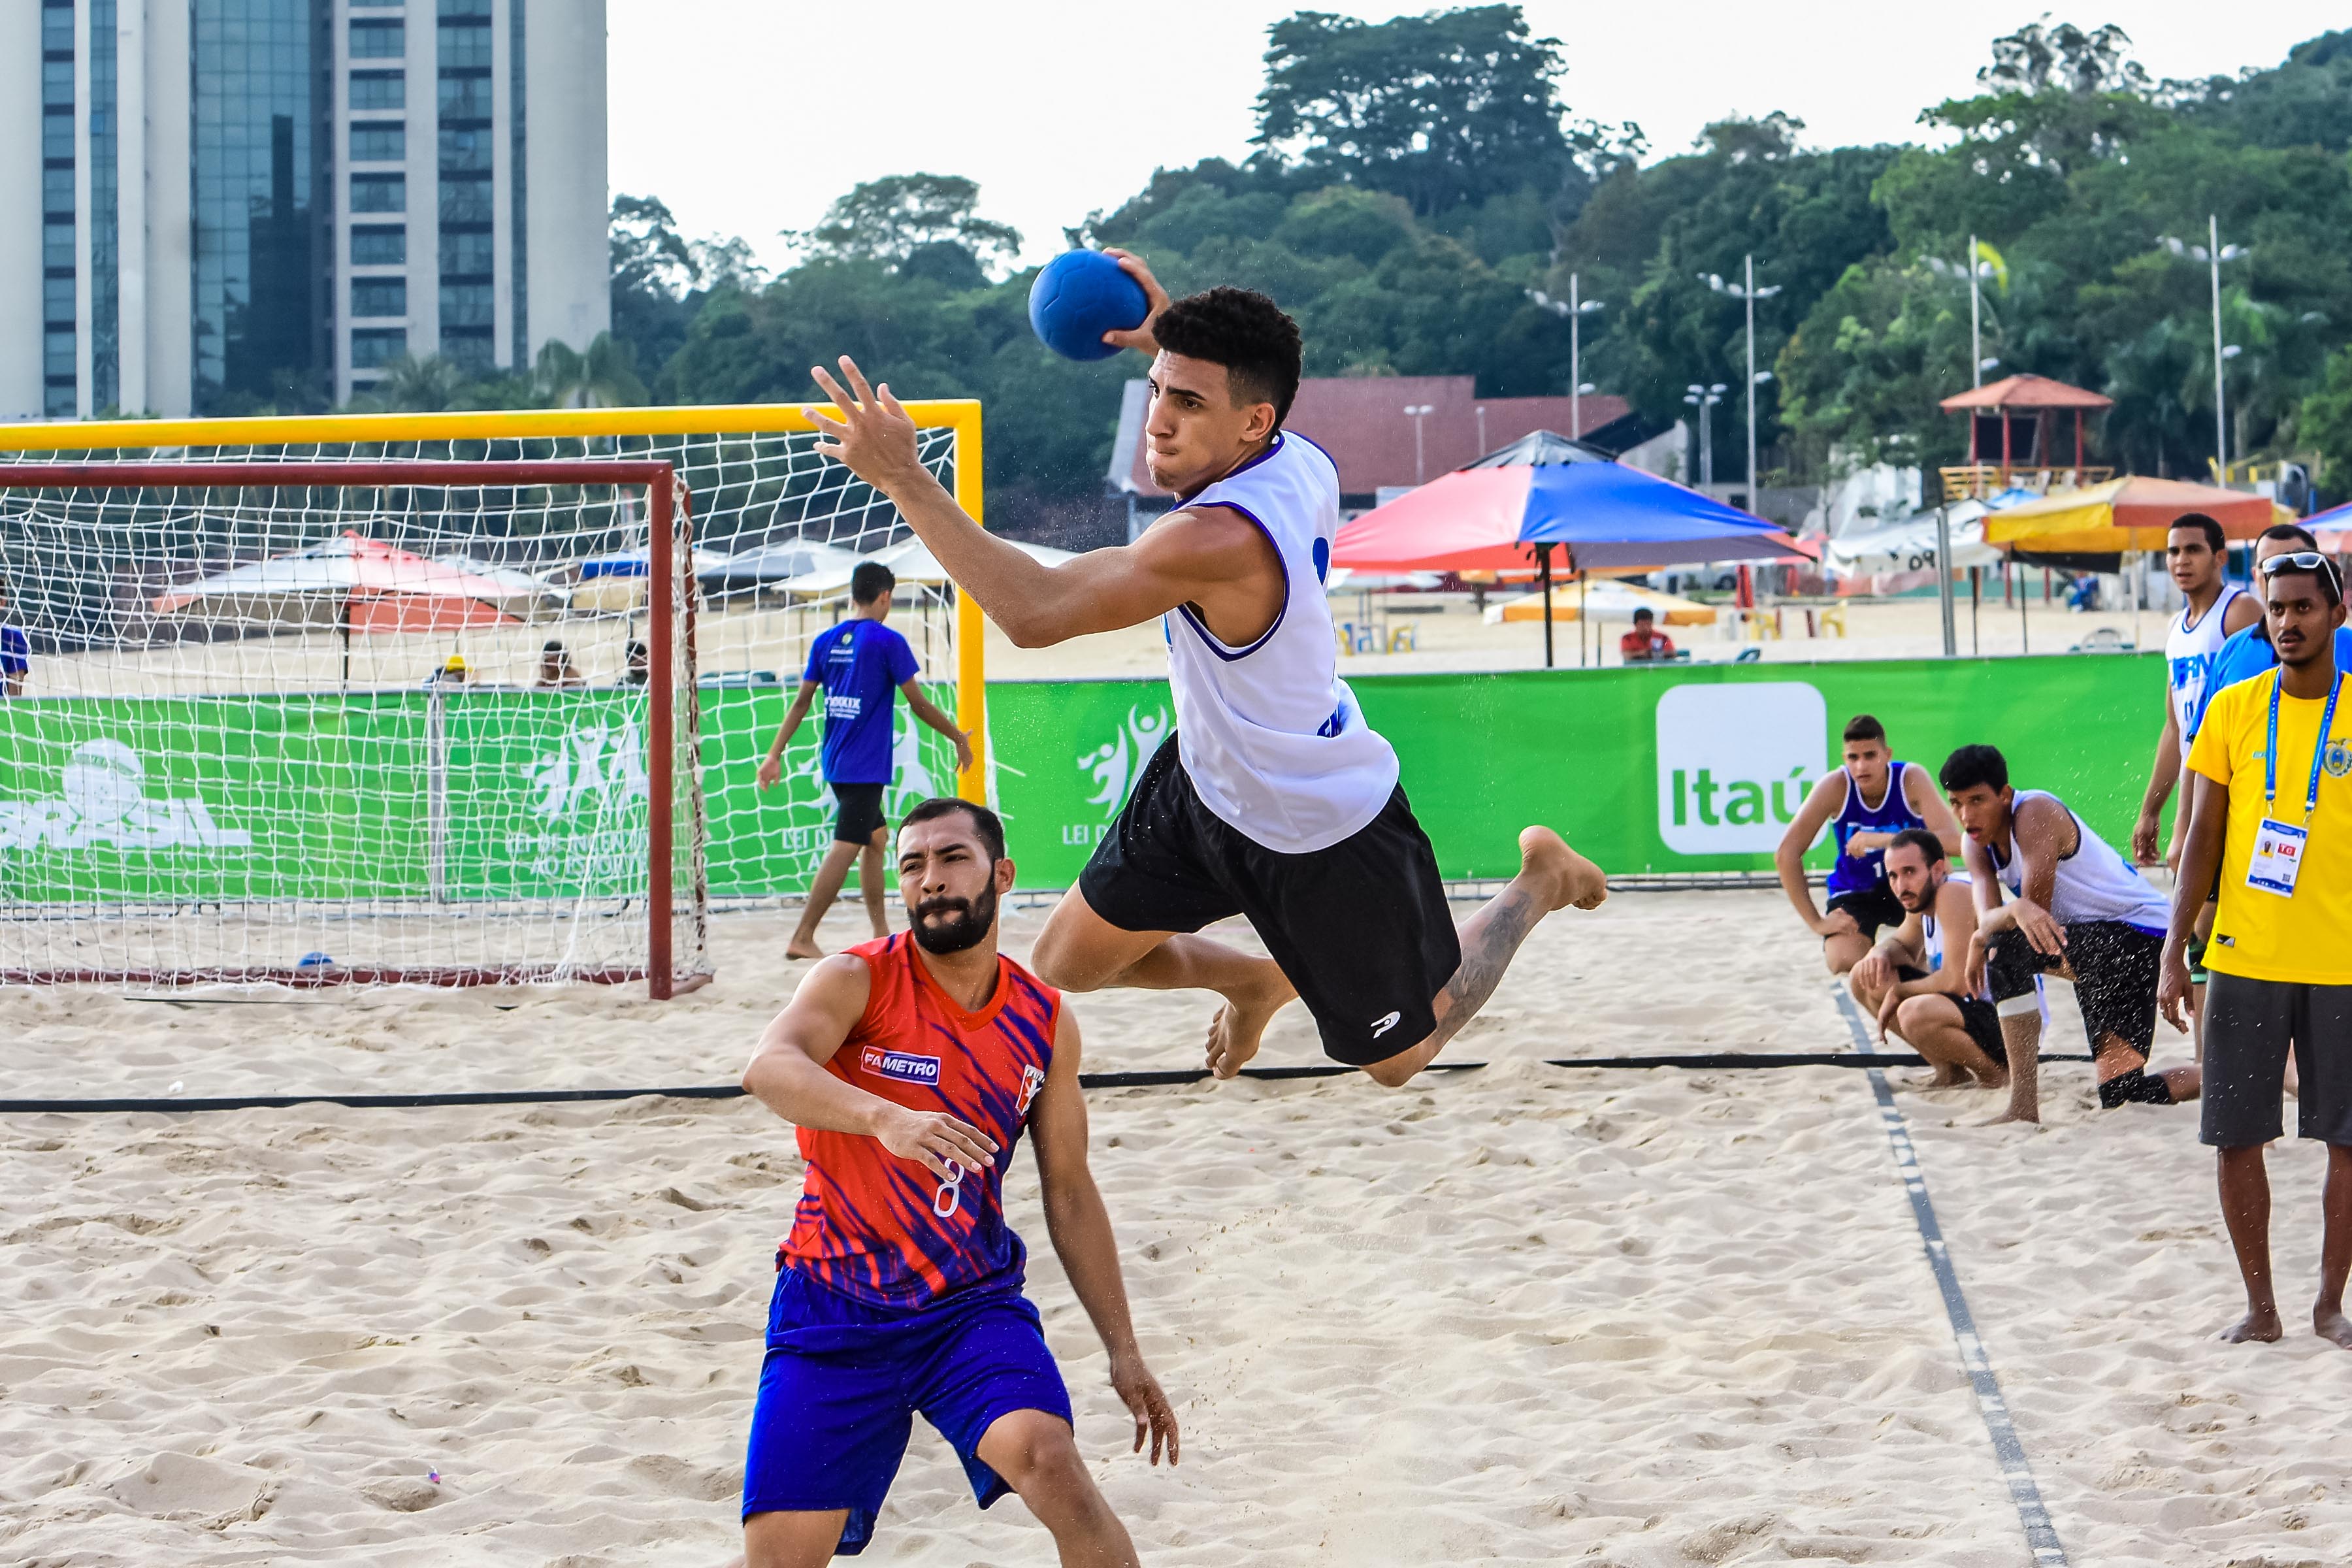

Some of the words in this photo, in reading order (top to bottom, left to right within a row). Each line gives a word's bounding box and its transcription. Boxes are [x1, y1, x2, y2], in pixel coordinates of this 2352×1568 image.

[1673, 766, 1813, 825] Itaú
[783, 829, 808, 849] LEI
[1063, 825, 1088, 844] LEI
[864, 1053, 937, 1077] FAMETRO
[934, 1158, 965, 1217] 8
